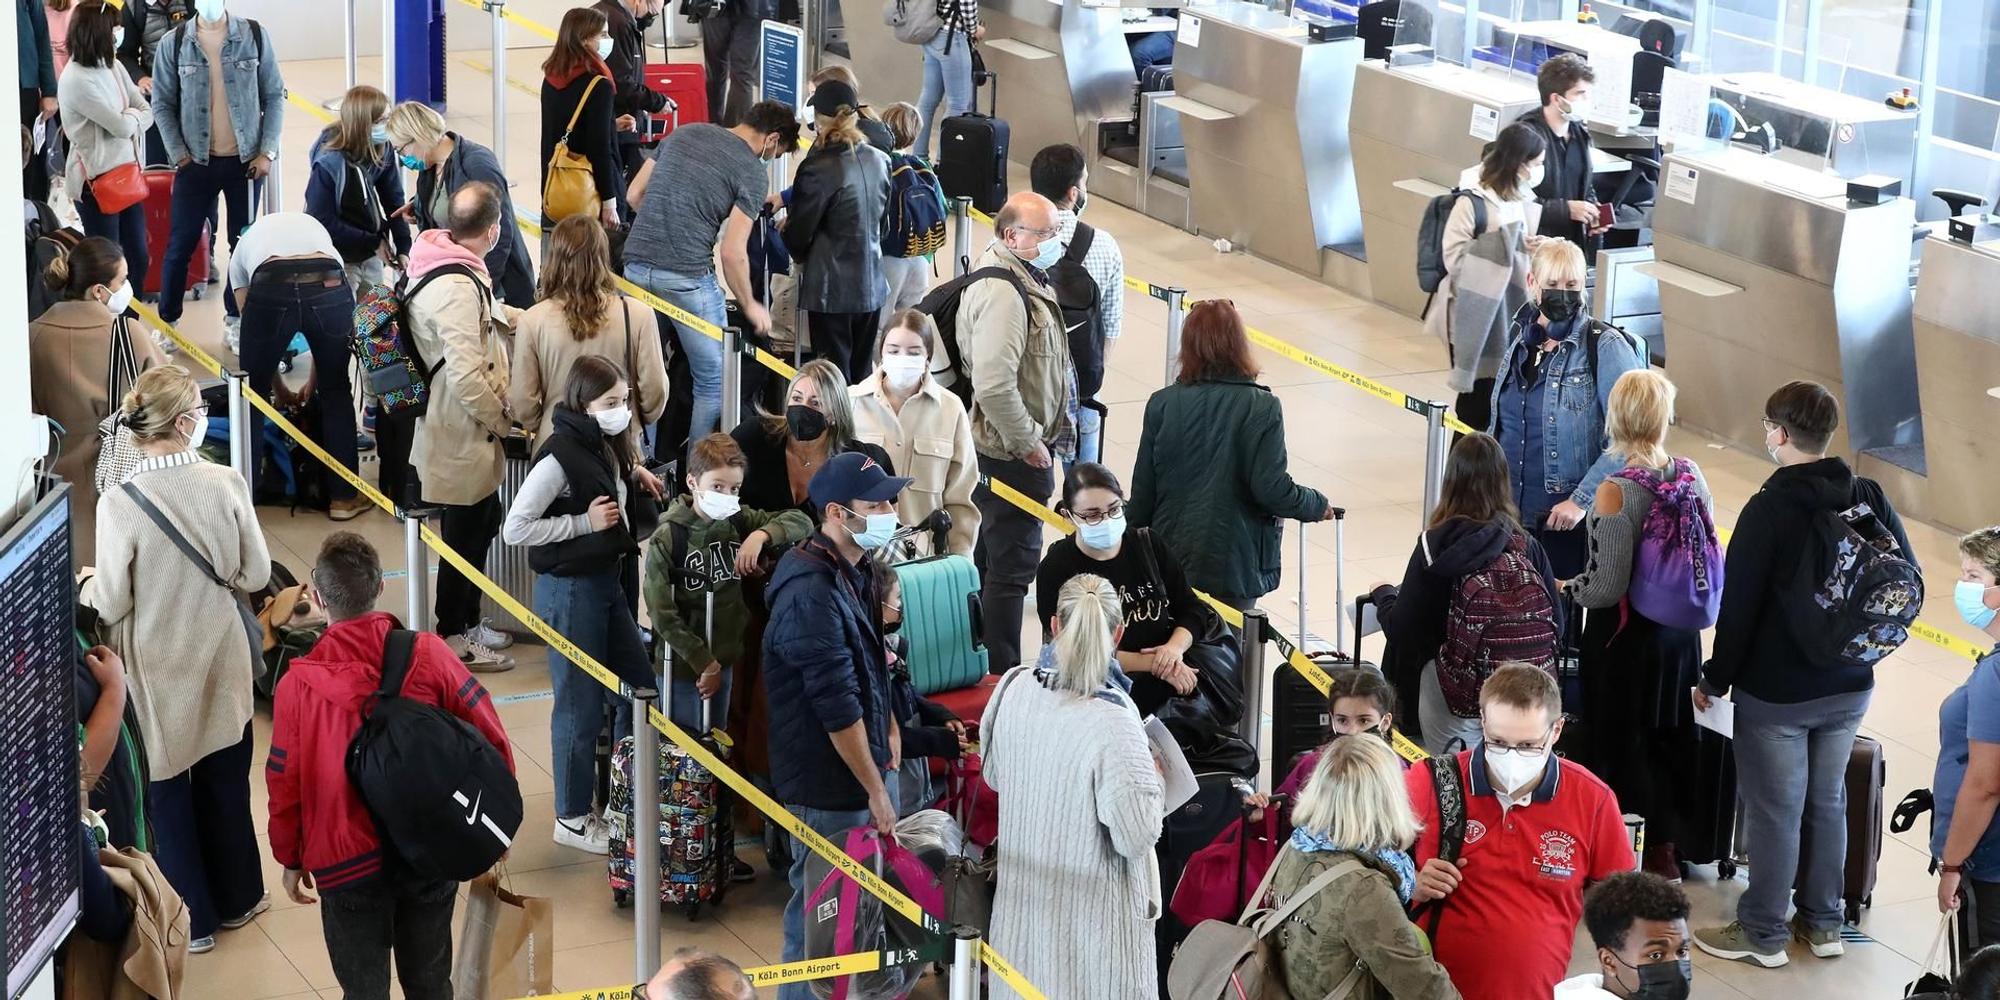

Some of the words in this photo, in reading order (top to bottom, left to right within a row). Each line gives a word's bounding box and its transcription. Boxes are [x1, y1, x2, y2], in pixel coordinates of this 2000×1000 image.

[826, 845, 841, 864] Airport
[889, 889, 904, 909] Airport
[758, 971, 778, 981] Köln
[782, 967, 804, 978] Bonn
[806, 962, 841, 976] Airport
[609, 990, 630, 1000] Köln
